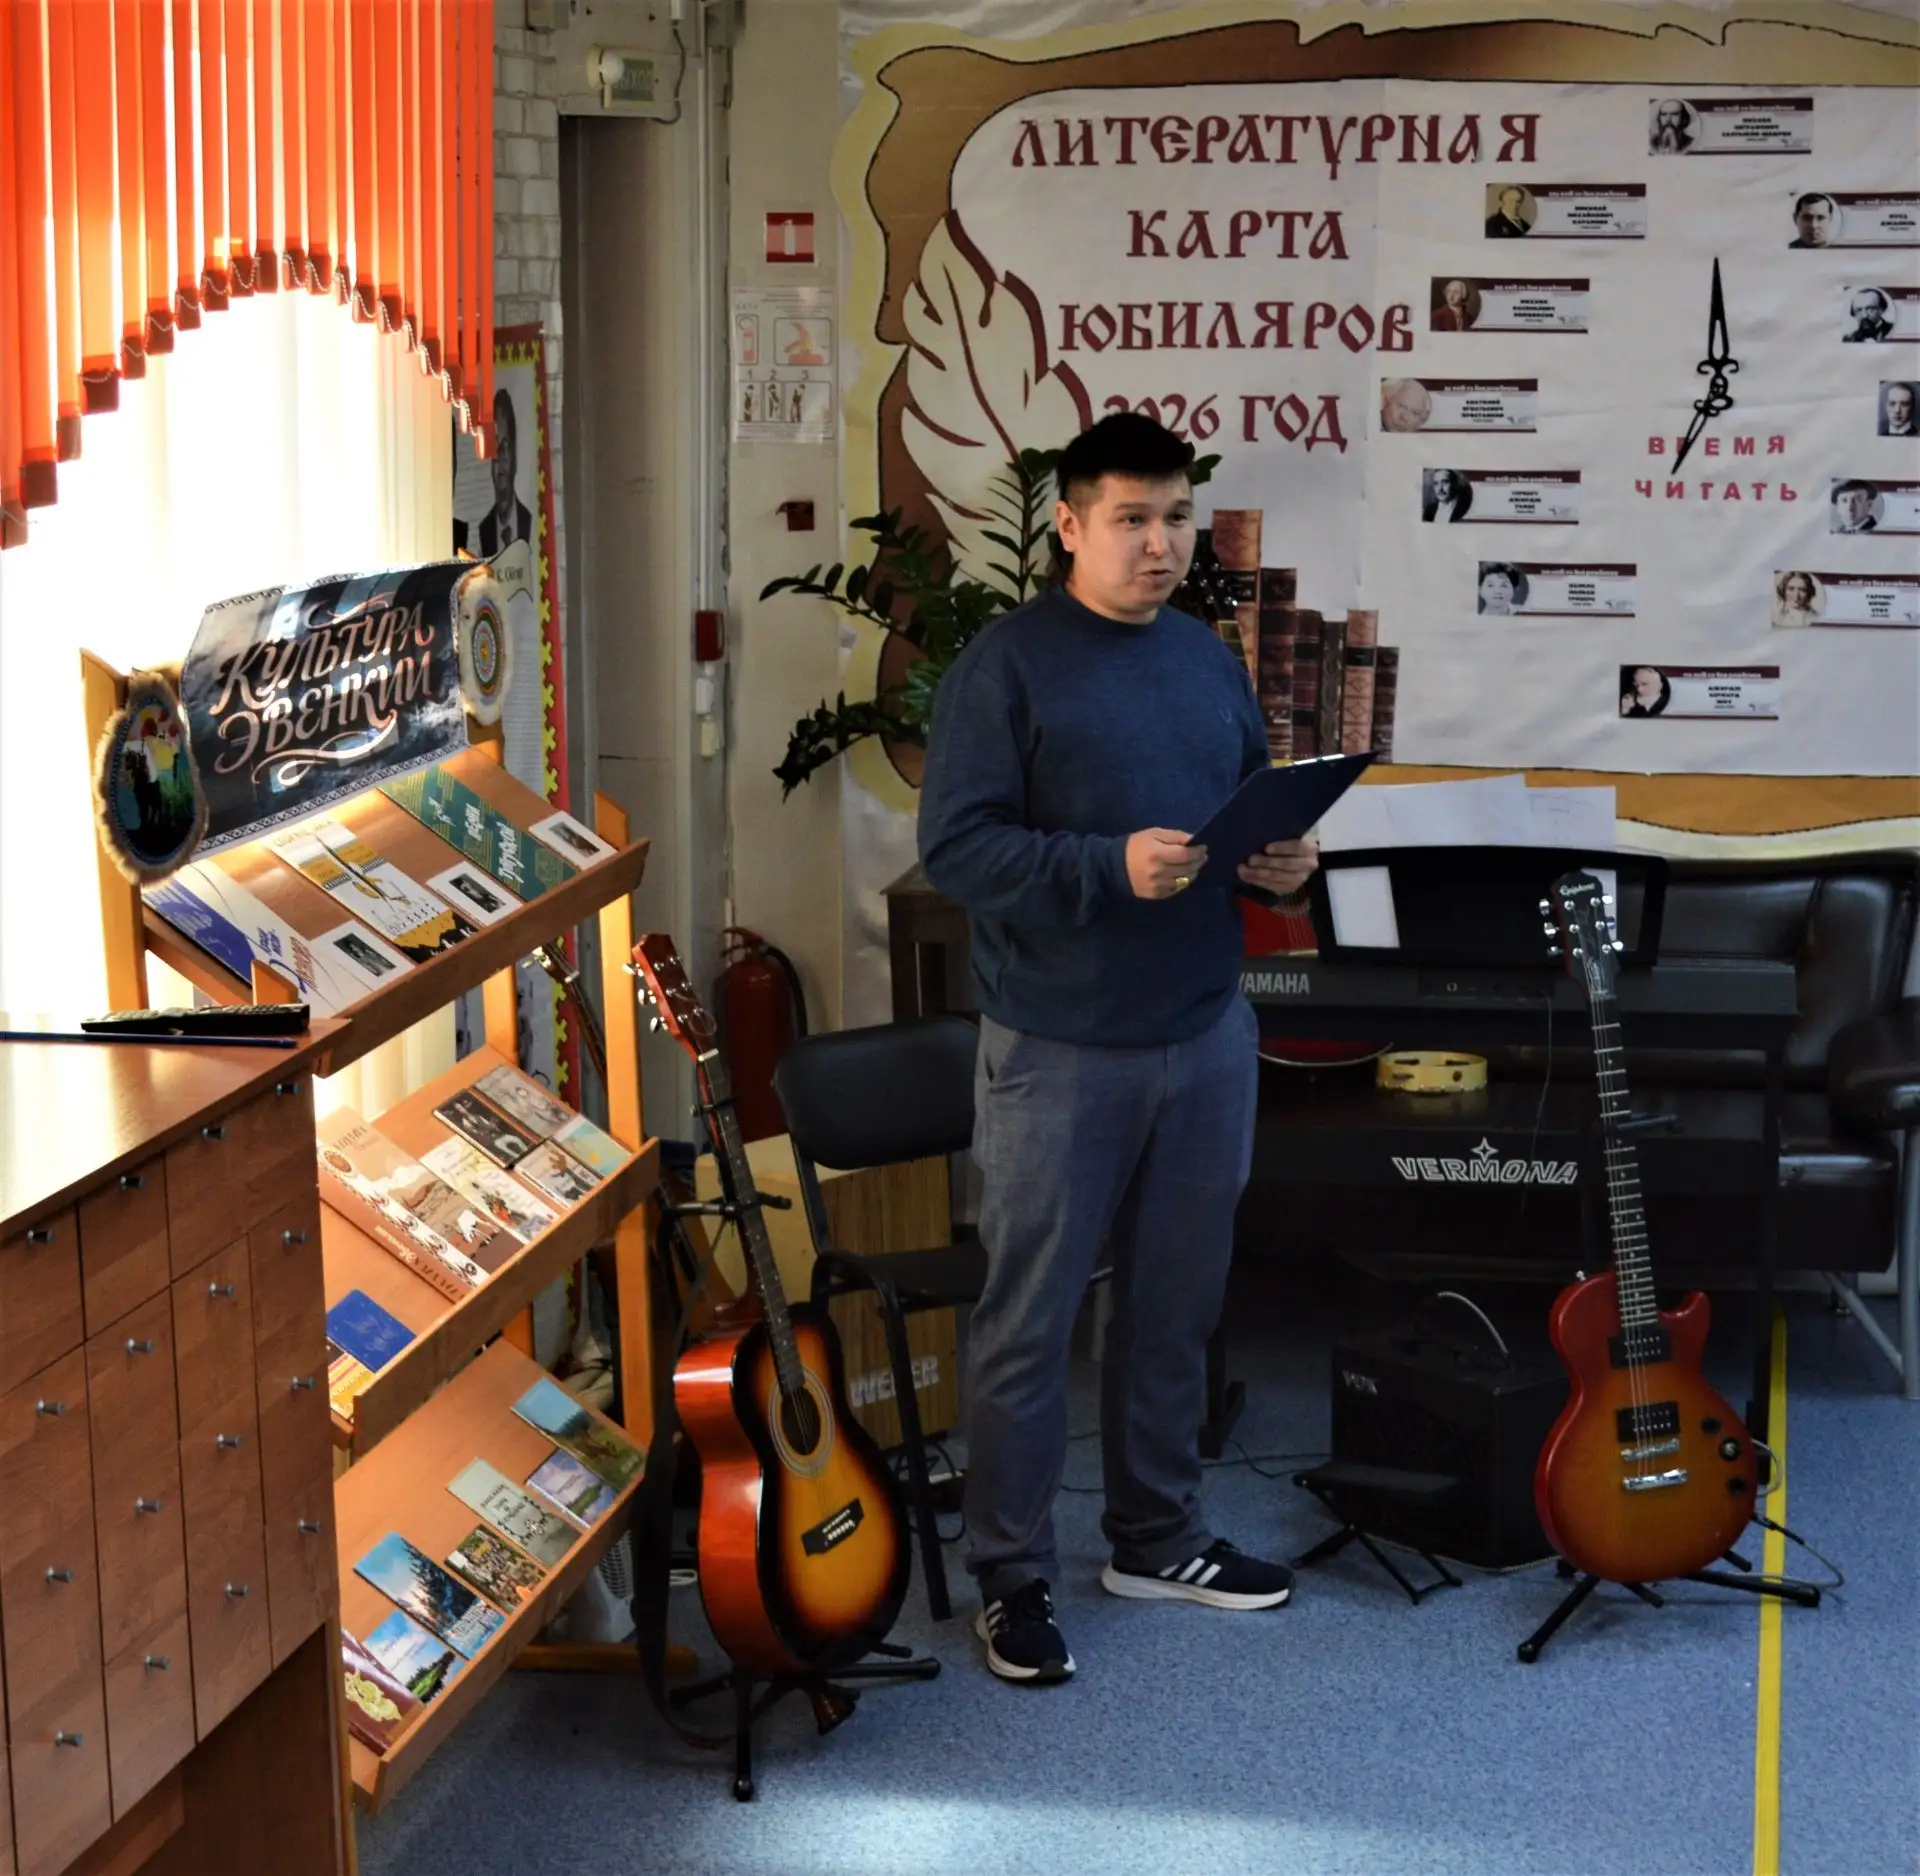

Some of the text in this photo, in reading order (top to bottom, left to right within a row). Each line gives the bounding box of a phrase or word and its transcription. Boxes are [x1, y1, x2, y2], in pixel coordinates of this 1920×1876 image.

[1012, 114, 1541, 180] ЛИТЕРАТУРНАЯ
[1126, 210, 1350, 260] КАРТА
[1058, 302, 1415, 353] ЮБИЛЯРОВ
[1239, 393, 1348, 454] ГОД
[1635, 479, 1797, 501] ЧИТАТЬ
[209, 592, 435, 716] КУЛЬТУРА
[213, 651, 432, 775] ЭВЕНКИИ
[1391, 1157, 1578, 1185] VERMONA
[850, 1355, 940, 1408] WEER
